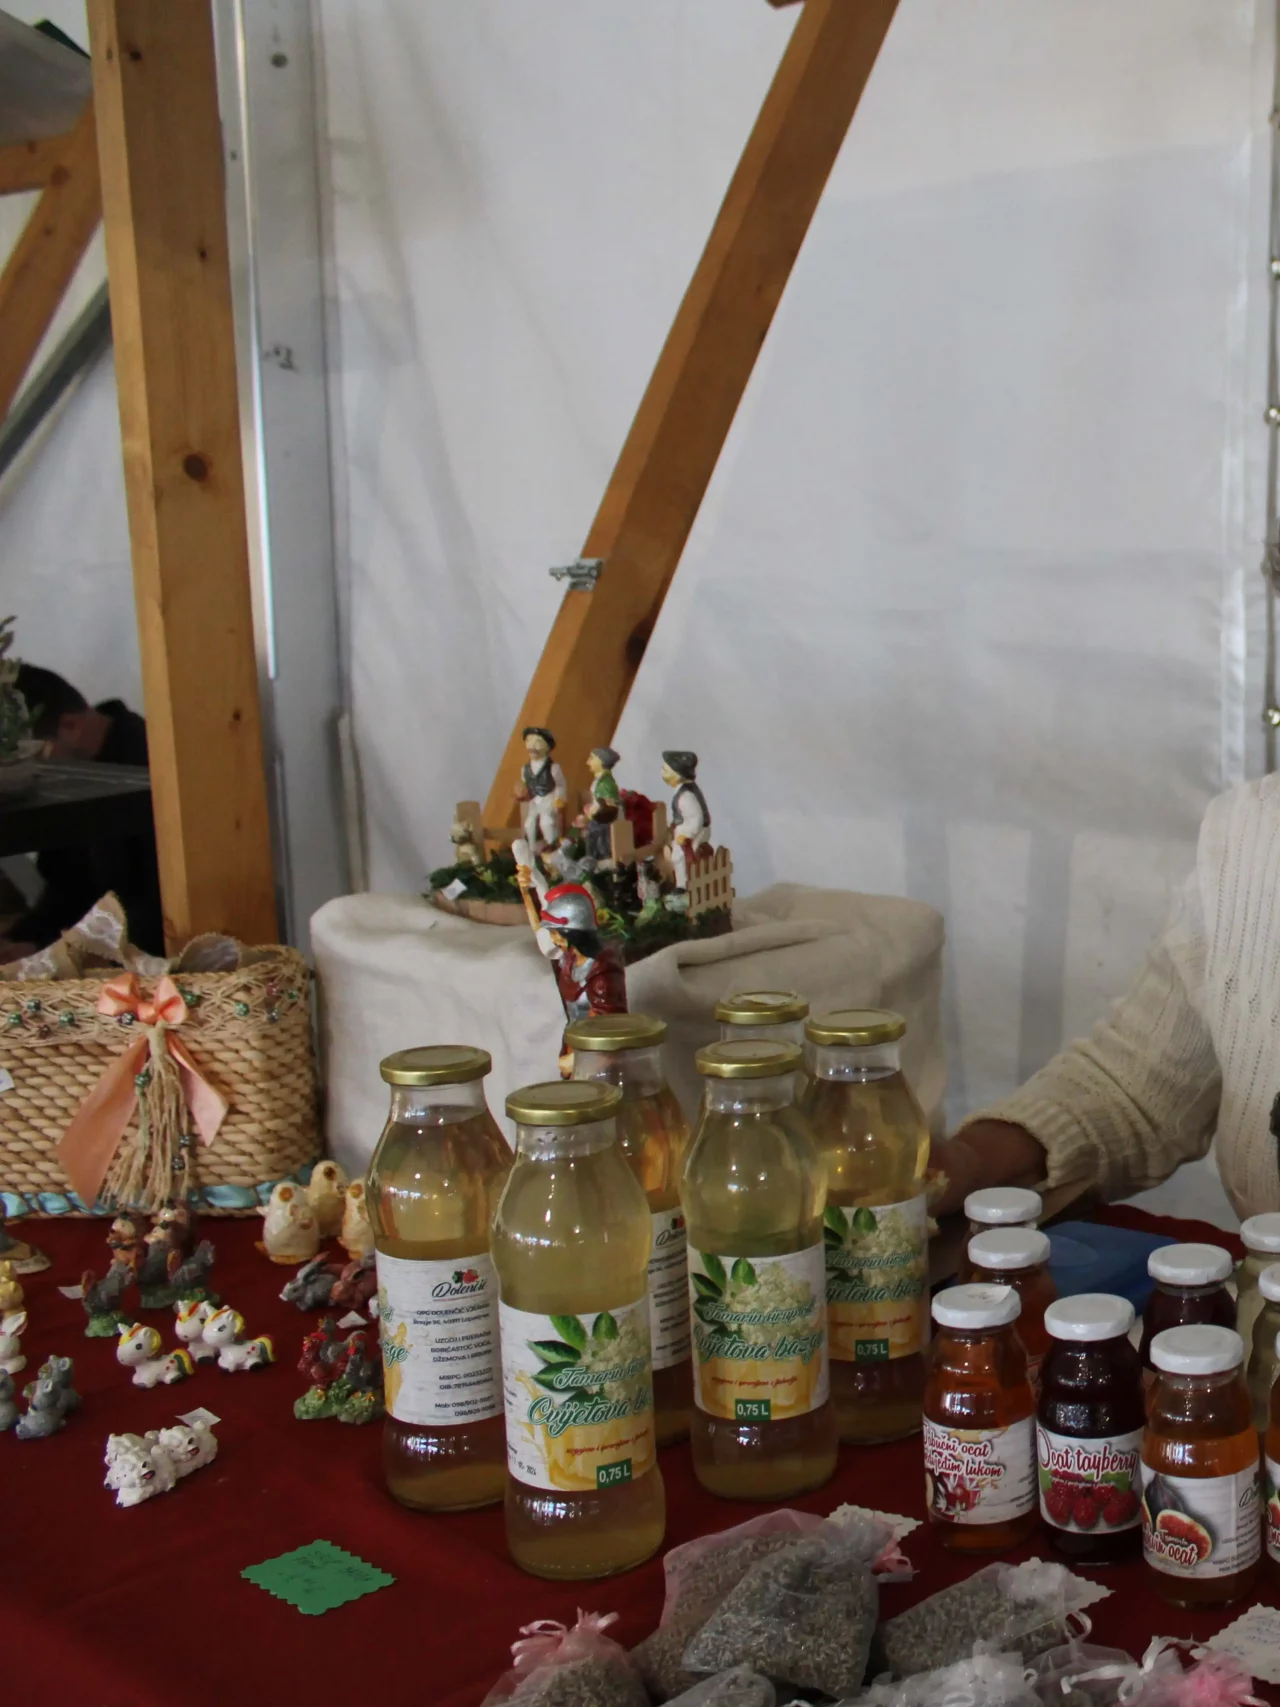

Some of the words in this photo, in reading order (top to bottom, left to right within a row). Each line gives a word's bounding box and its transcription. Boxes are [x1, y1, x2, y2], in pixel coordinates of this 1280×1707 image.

[857, 1343, 879, 1356] 0,75
[880, 1343, 887, 1354] L
[553, 1367, 622, 1390] Tamarin
[527, 1394, 630, 1437] Cvijetova
[736, 1405, 760, 1416] 0,75
[761, 1404, 769, 1415] L
[961, 1443, 990, 1458] ocat
[965, 1461, 1003, 1478] lukom
[1076, 1444, 1139, 1480] tayberry
[598, 1467, 623, 1484] 0,75
[623, 1467, 631, 1480] L
[1168, 1544, 1197, 1566] ocat
